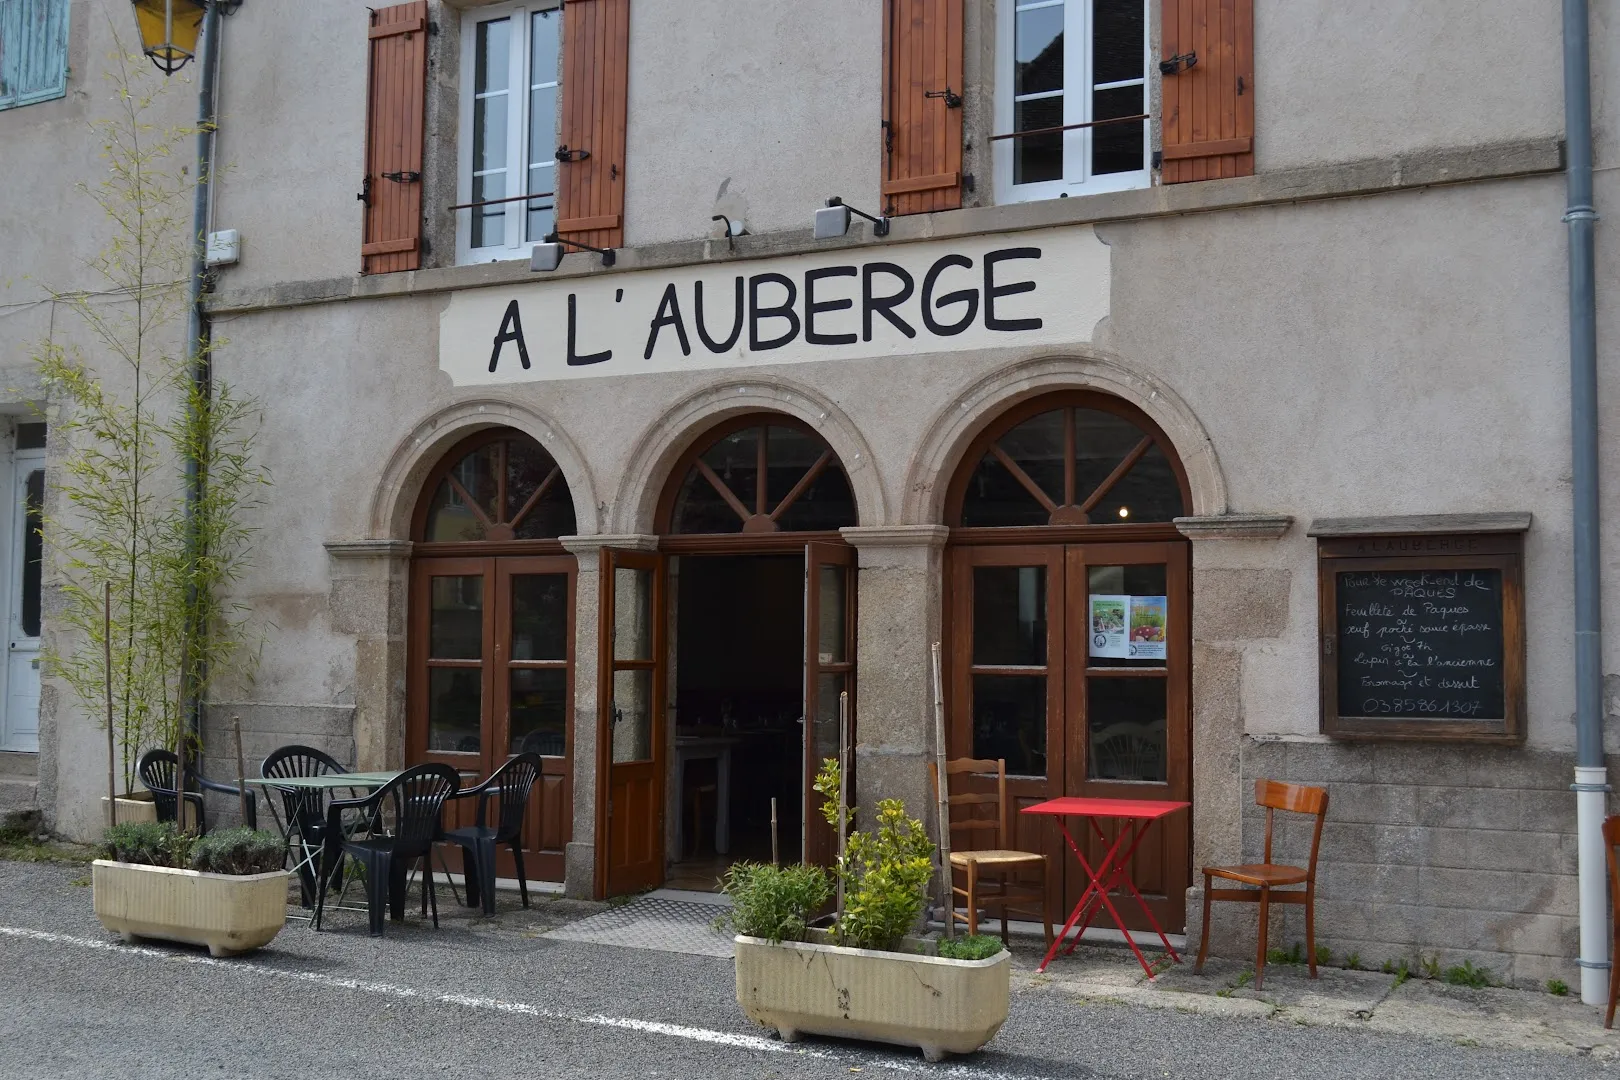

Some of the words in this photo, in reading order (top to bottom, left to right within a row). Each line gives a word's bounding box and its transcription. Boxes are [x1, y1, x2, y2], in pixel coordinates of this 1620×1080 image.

[488, 299, 531, 373] A
[566, 246, 1043, 367] L'AUBERGE
[1464, 573, 1492, 590] de
[1345, 602, 1395, 617] Feuilleté
[1402, 604, 1417, 616] de
[1376, 623, 1413, 638] poché
[1420, 625, 1449, 633] sauce
[1354, 652, 1389, 669] Lapin
[1427, 655, 1495, 667] l'ancienne
[1419, 675, 1432, 688] et
